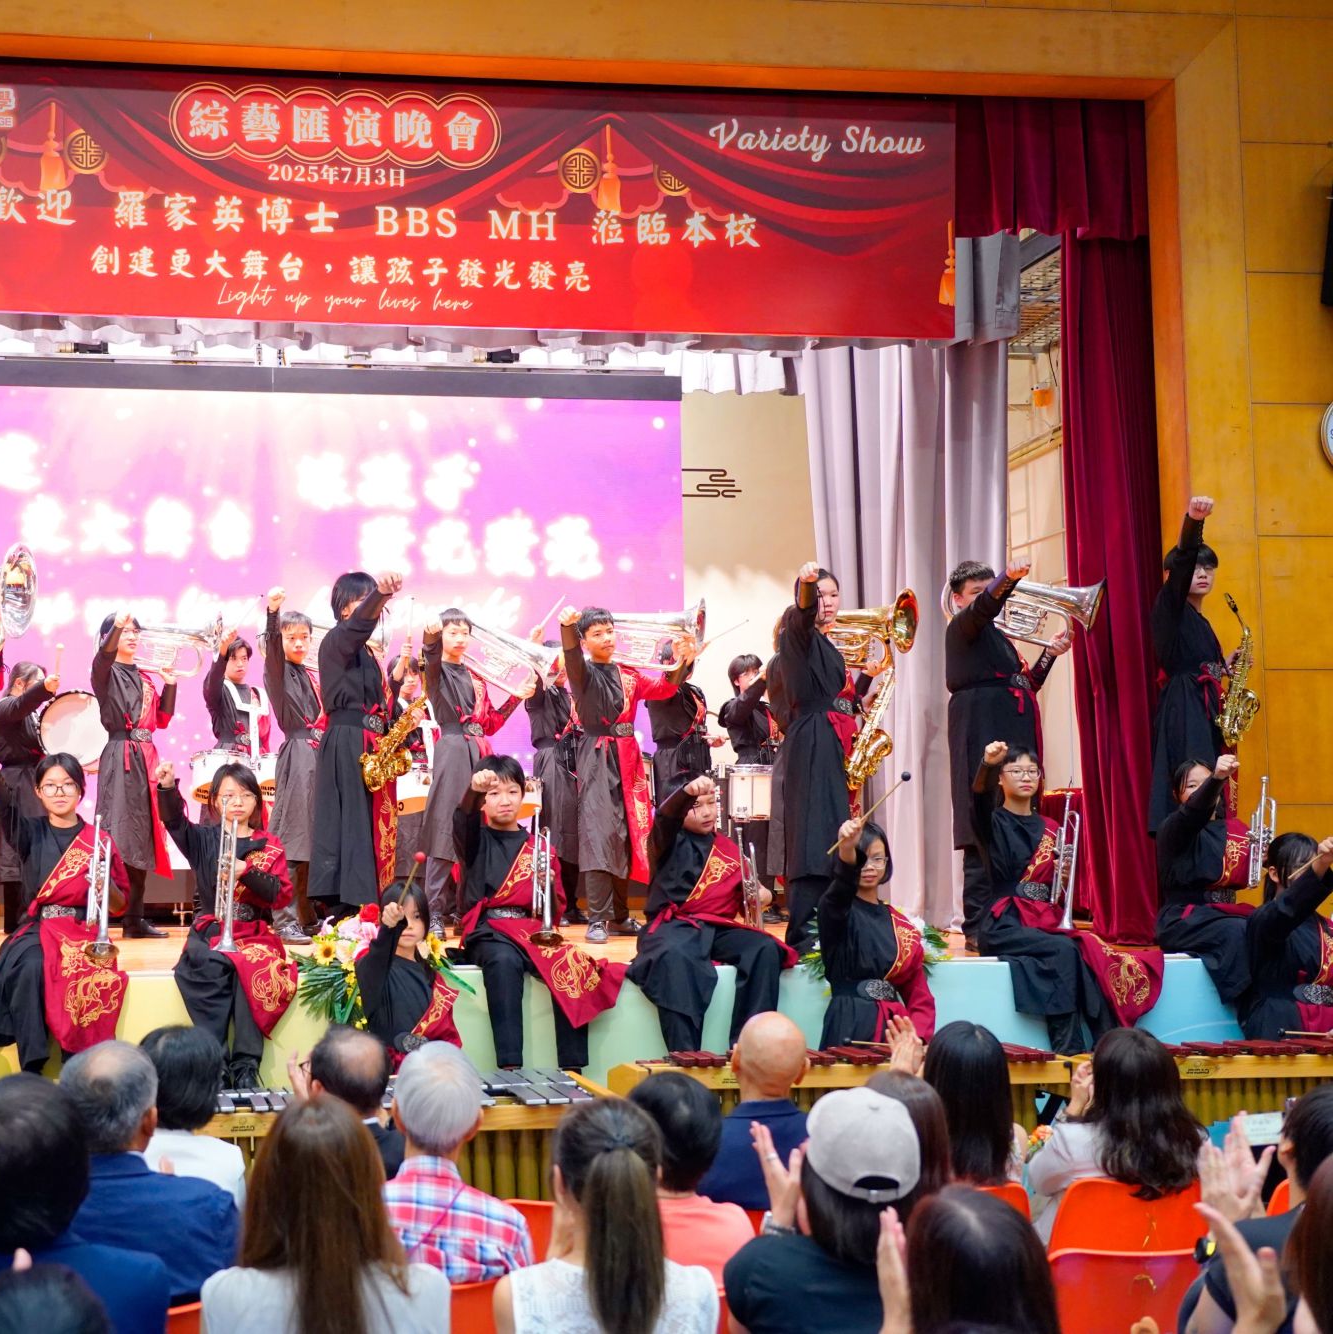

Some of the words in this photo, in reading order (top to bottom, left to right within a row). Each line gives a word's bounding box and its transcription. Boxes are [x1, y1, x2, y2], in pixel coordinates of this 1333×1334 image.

[189, 100, 482, 151] 綜藝匯演晚會
[708, 118, 832, 163] Variety
[841, 125, 926, 154] Show
[268, 163, 405, 188] 2025年7月3日
[114, 191, 339, 236] 羅家英博士
[375, 205, 458, 239] BBS
[488, 209, 558, 241] MH
[591, 209, 761, 249] 蒞臨本校
[217, 281, 277, 315] Light
[284, 291, 312, 314] up
[324, 295, 366, 315] your
[379, 288, 421, 311] lives
[432, 288, 474, 311] here
